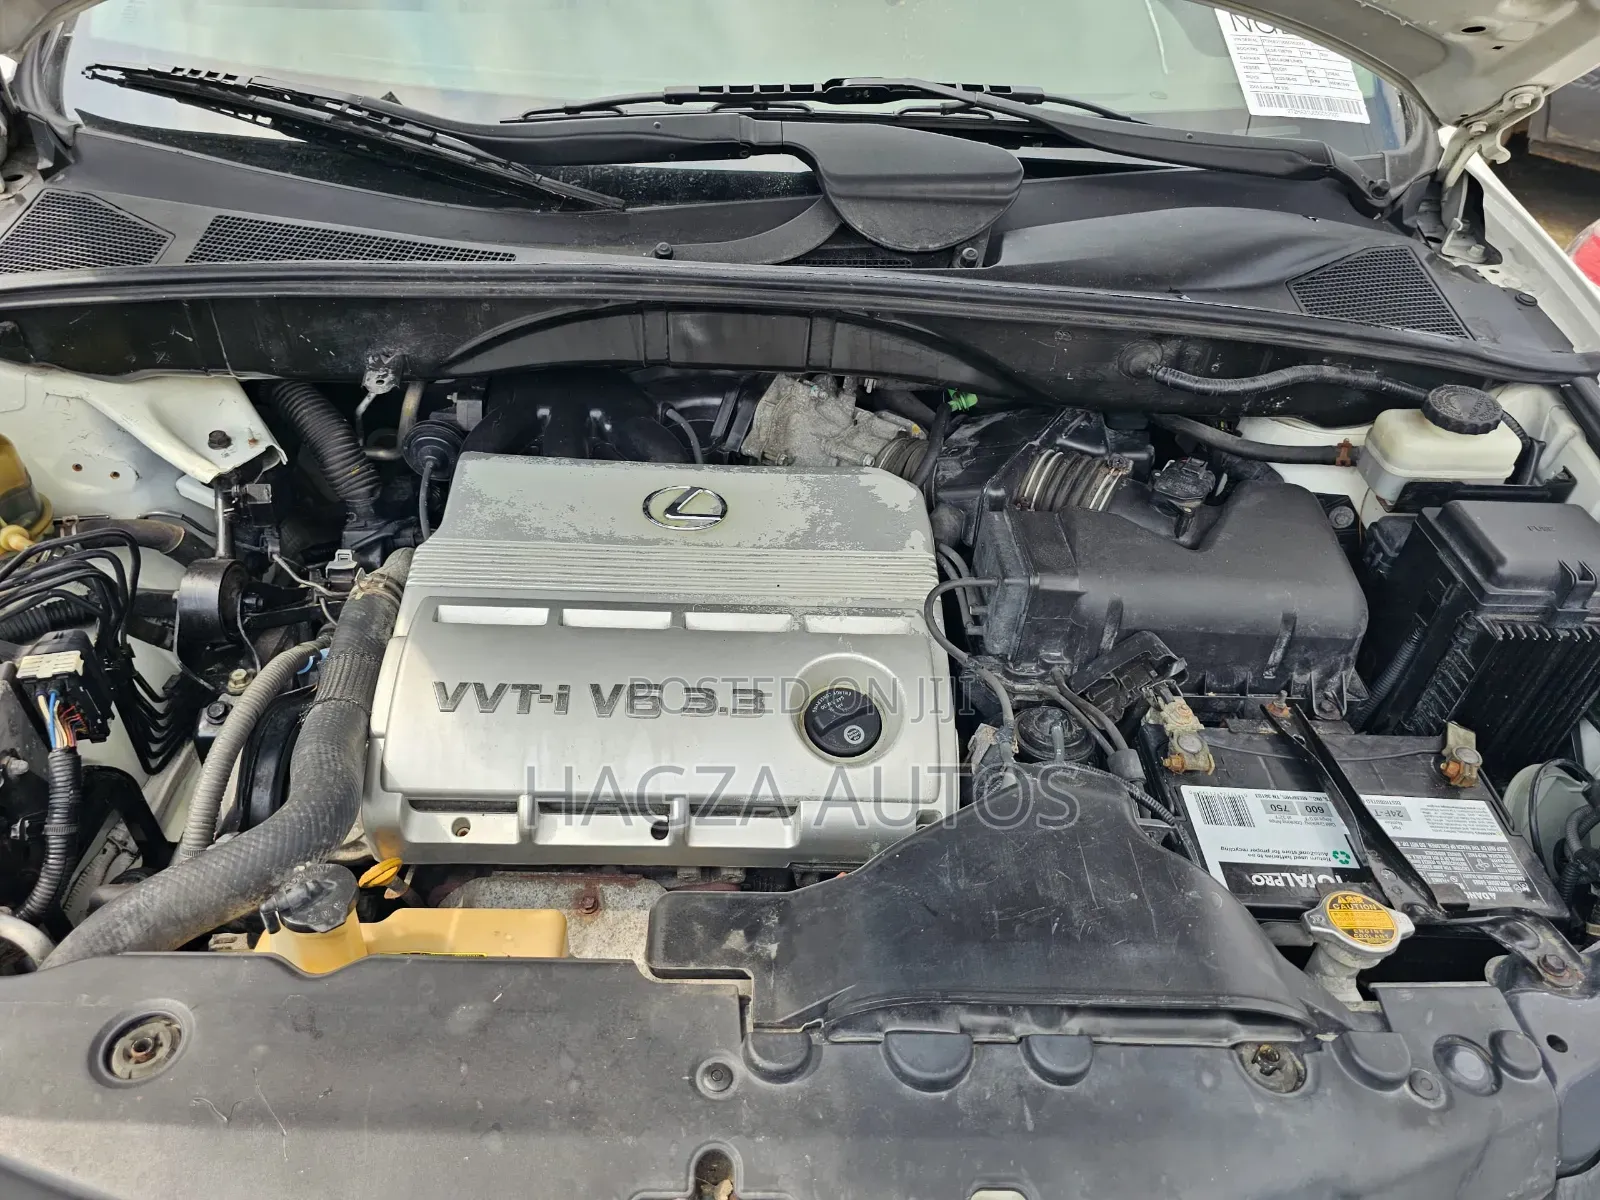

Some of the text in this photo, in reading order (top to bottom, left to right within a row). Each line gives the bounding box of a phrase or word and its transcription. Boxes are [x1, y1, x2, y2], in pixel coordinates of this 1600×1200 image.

[432, 681, 766, 719] VVT-i V6 3.3
[1270, 804, 1290, 813] 750
[1305, 805, 1325, 814] 600
[1374, 809, 1404, 818] 24F-T
[1332, 903, 1377, 911] CAUTION
